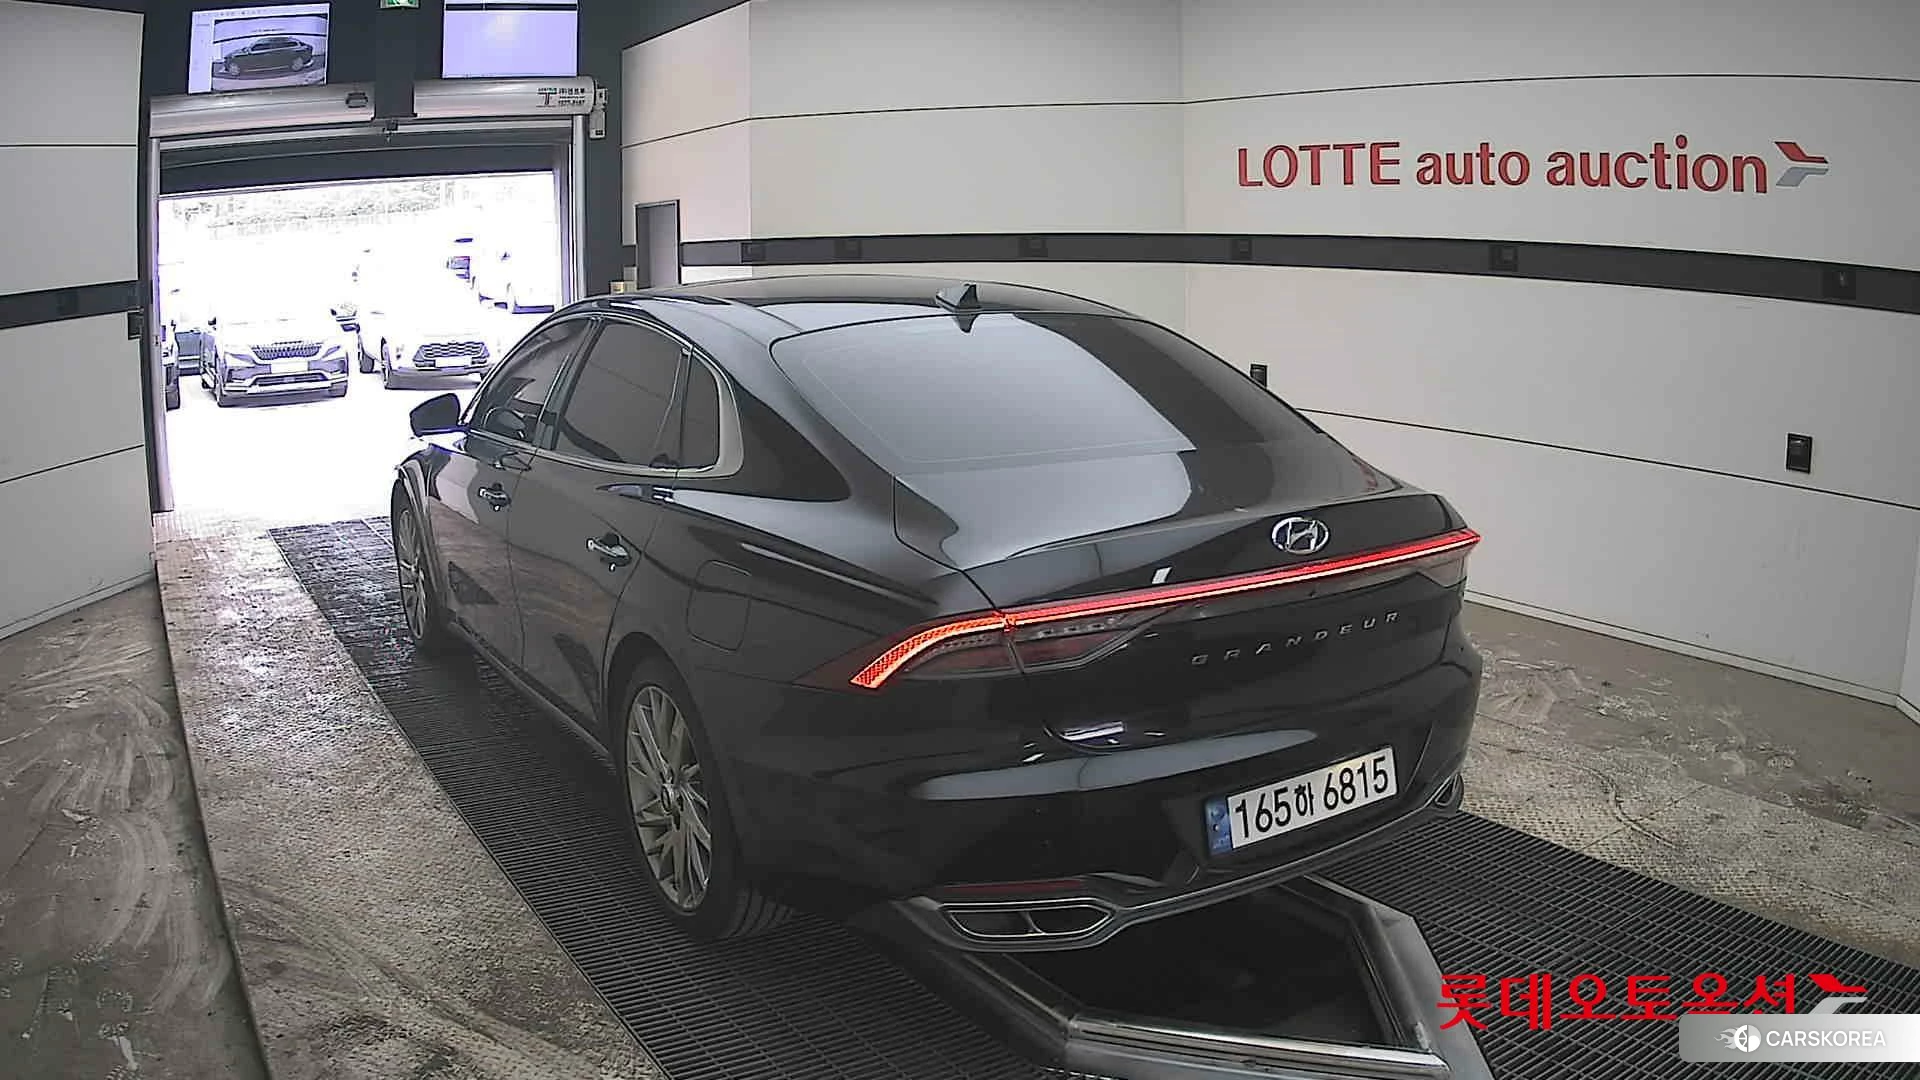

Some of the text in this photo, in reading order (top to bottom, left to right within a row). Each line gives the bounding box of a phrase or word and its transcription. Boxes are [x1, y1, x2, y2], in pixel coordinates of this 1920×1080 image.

[1238, 134, 1768, 194] LOTTE auto auction
[1191, 612, 1399, 665] GRANDEUR
[1235, 756, 1388, 838] 165하 6815
